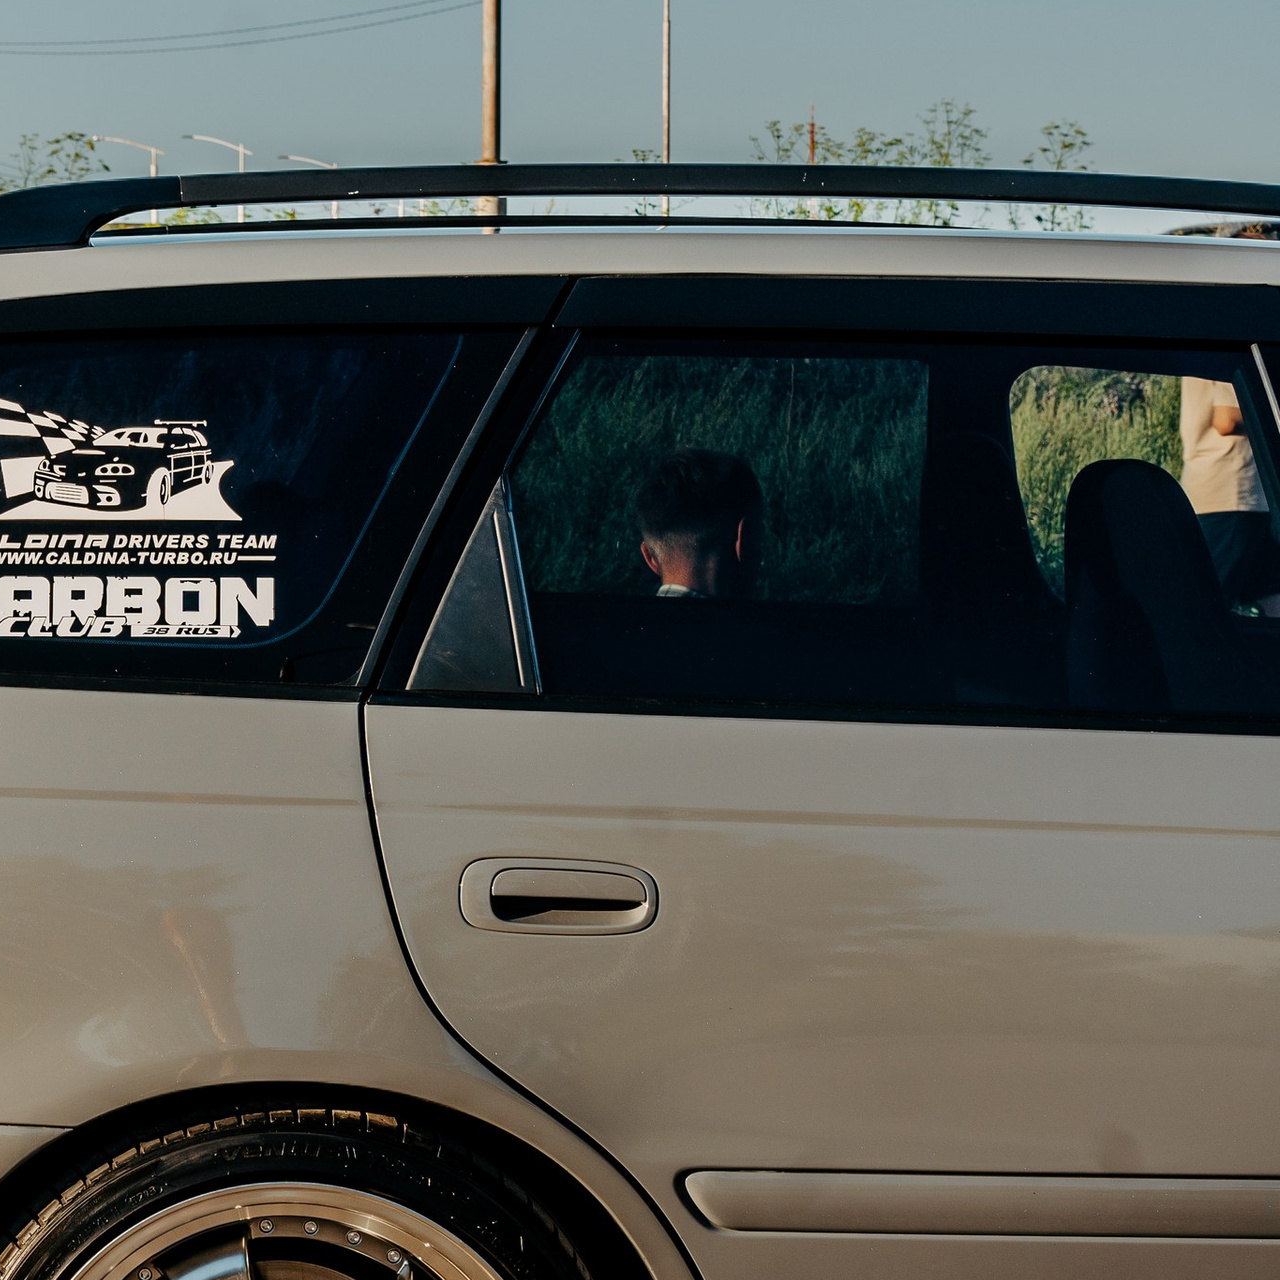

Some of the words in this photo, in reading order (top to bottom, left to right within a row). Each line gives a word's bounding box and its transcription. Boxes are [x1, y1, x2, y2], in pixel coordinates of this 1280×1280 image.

[114, 535, 209, 549] DRIVERS
[217, 535, 277, 549] TEAM
[143, 626, 169, 636] 38
[176, 626, 221, 636] RUS
